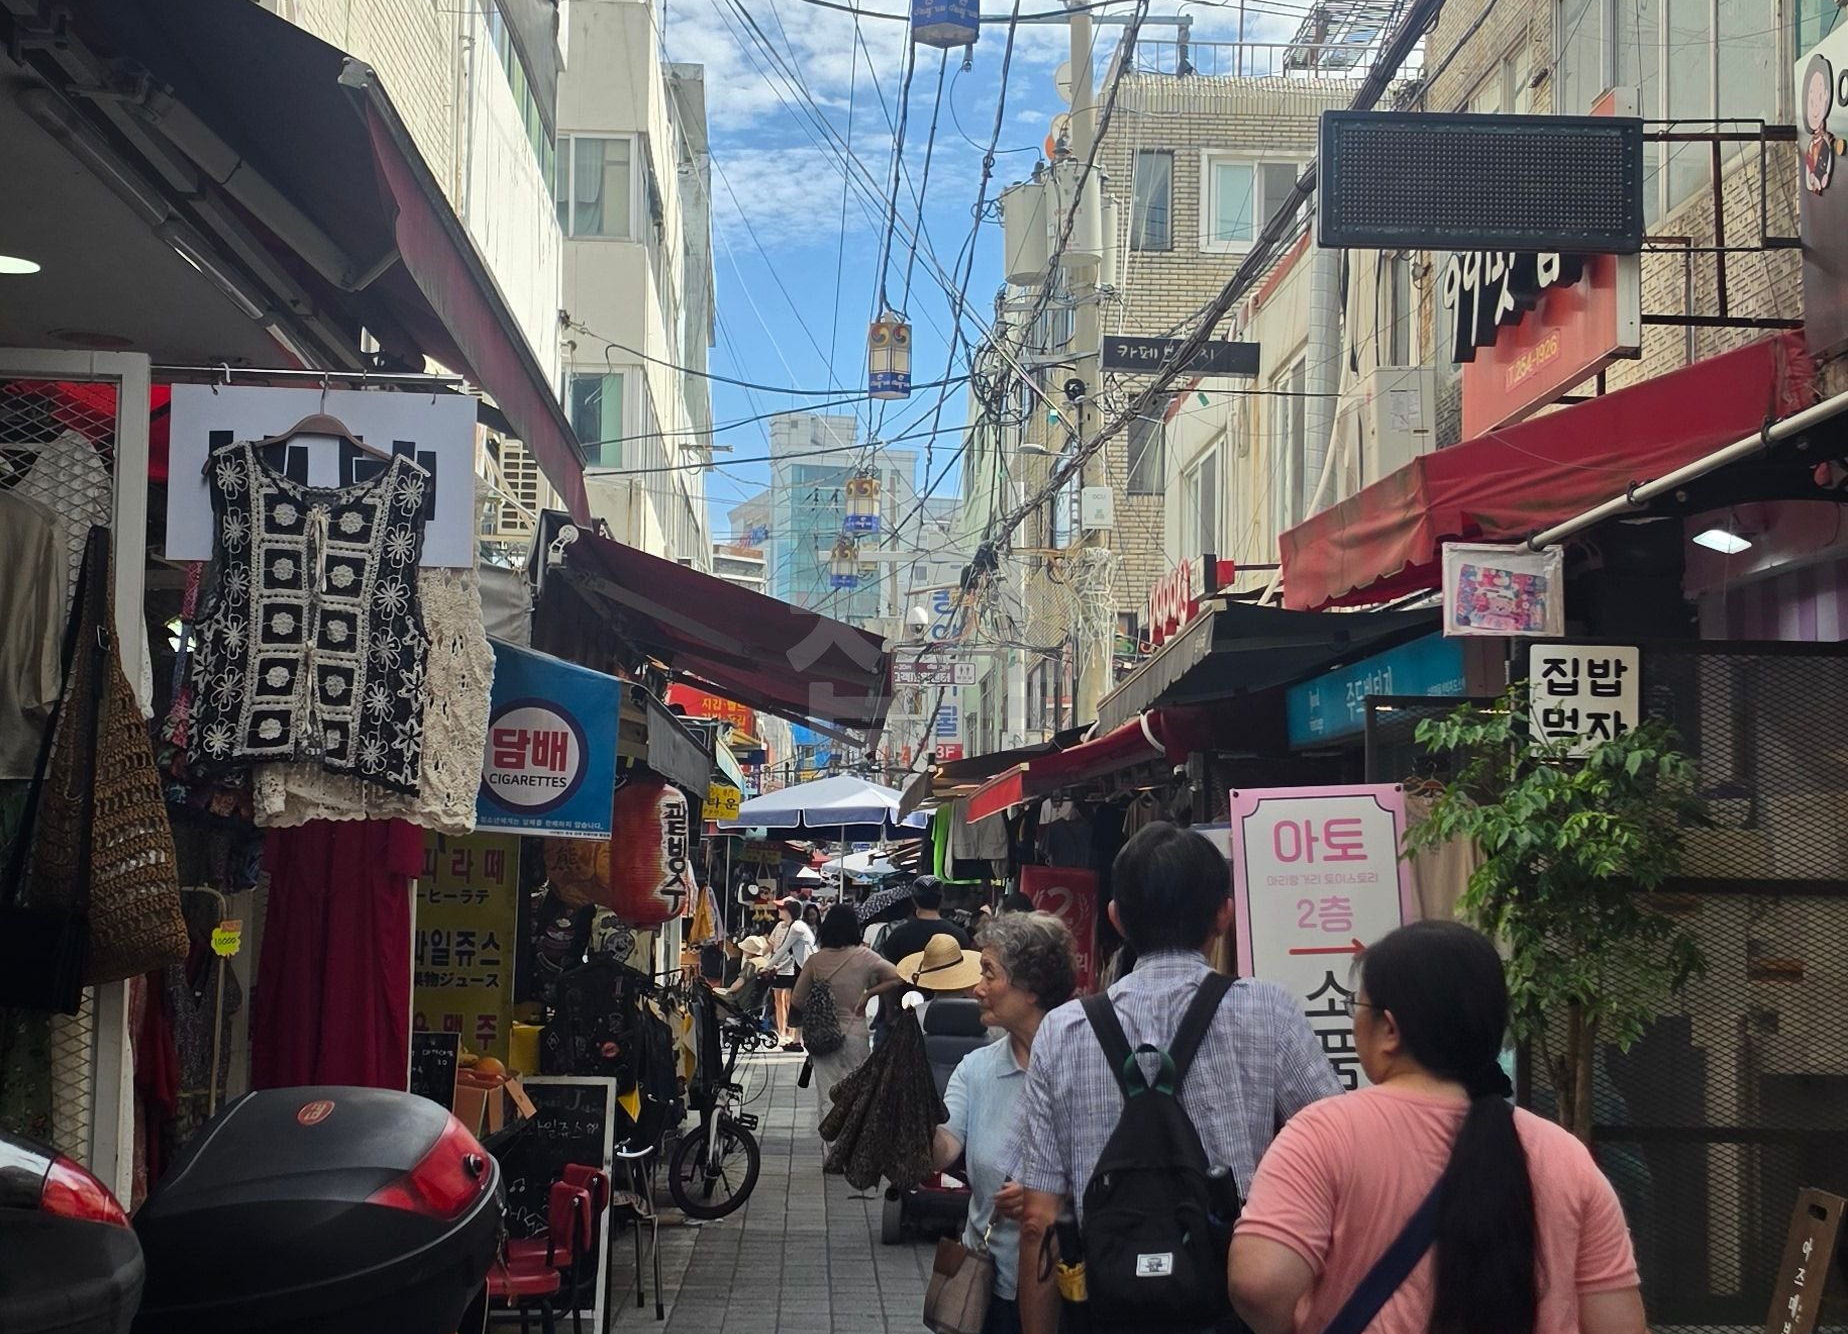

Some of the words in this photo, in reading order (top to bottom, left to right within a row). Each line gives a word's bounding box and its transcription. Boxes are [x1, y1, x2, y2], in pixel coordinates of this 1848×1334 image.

[1117, 345, 1158, 360] 카페
[1541, 657, 1629, 697] 집밥
[1542, 707, 1629, 747] 먹자
[493, 728, 569, 772] 담배
[935, 745, 956, 760] 3F
[488, 772, 567, 788] CIGARETTES
[1273, 817, 1369, 864] 아토
[1324, 871, 1379, 884] 토이스토리
[1297, 895, 1354, 933] 2층
